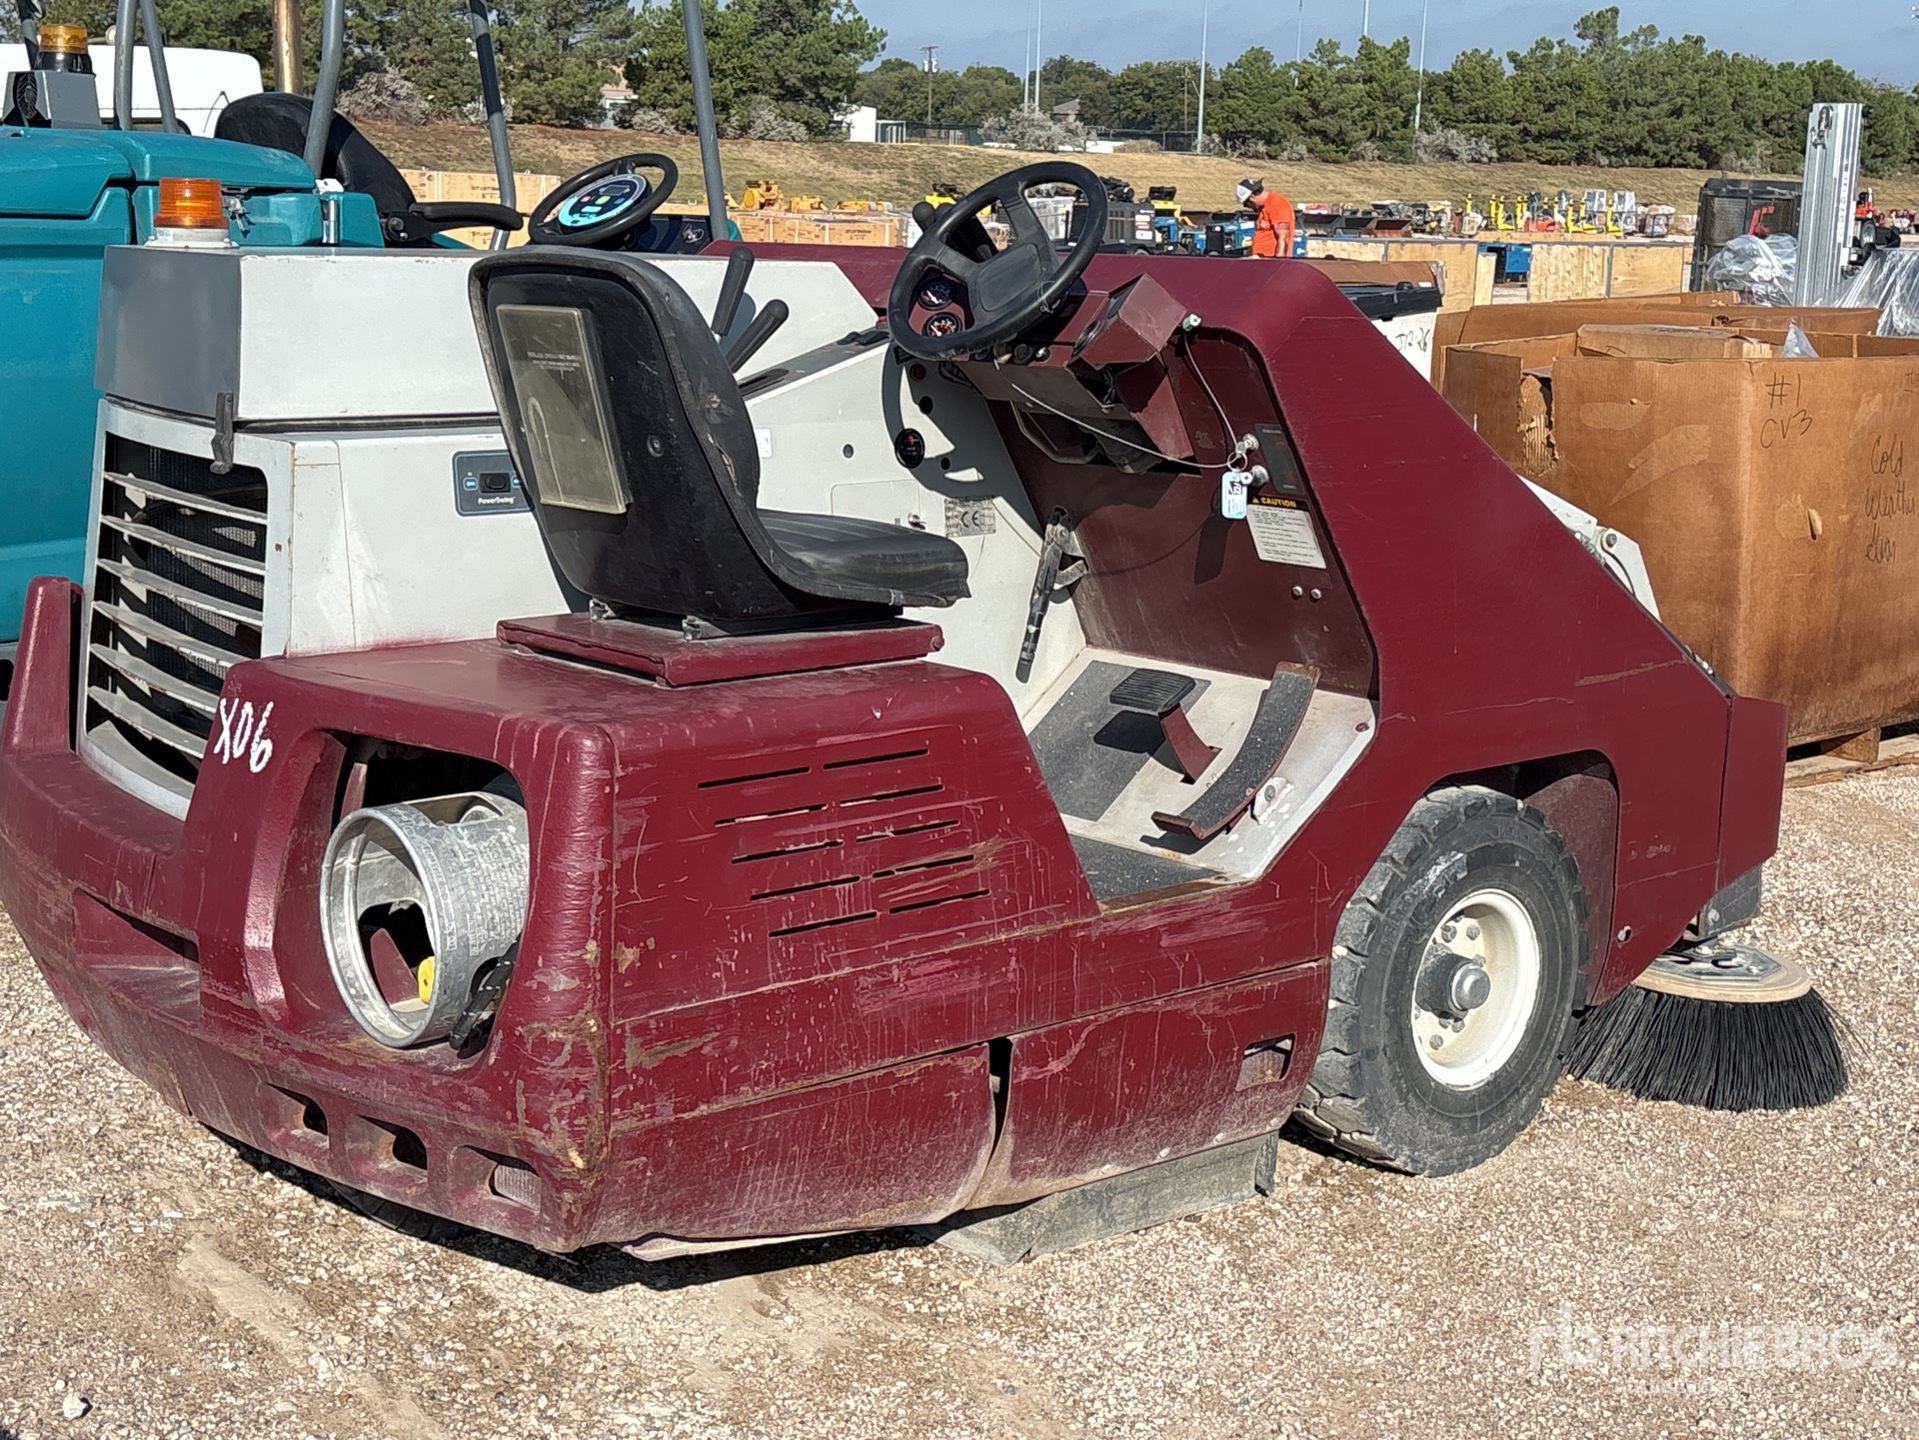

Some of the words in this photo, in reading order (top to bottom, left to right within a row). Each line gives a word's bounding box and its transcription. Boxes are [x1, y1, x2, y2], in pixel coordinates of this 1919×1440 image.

[1765, 372, 1801, 408] #1
[1870, 433, 1904, 478] Cold
[961, 510, 980, 529] CE
[1261, 497, 1296, 507] CAUTION
[213, 697, 274, 774] X06
